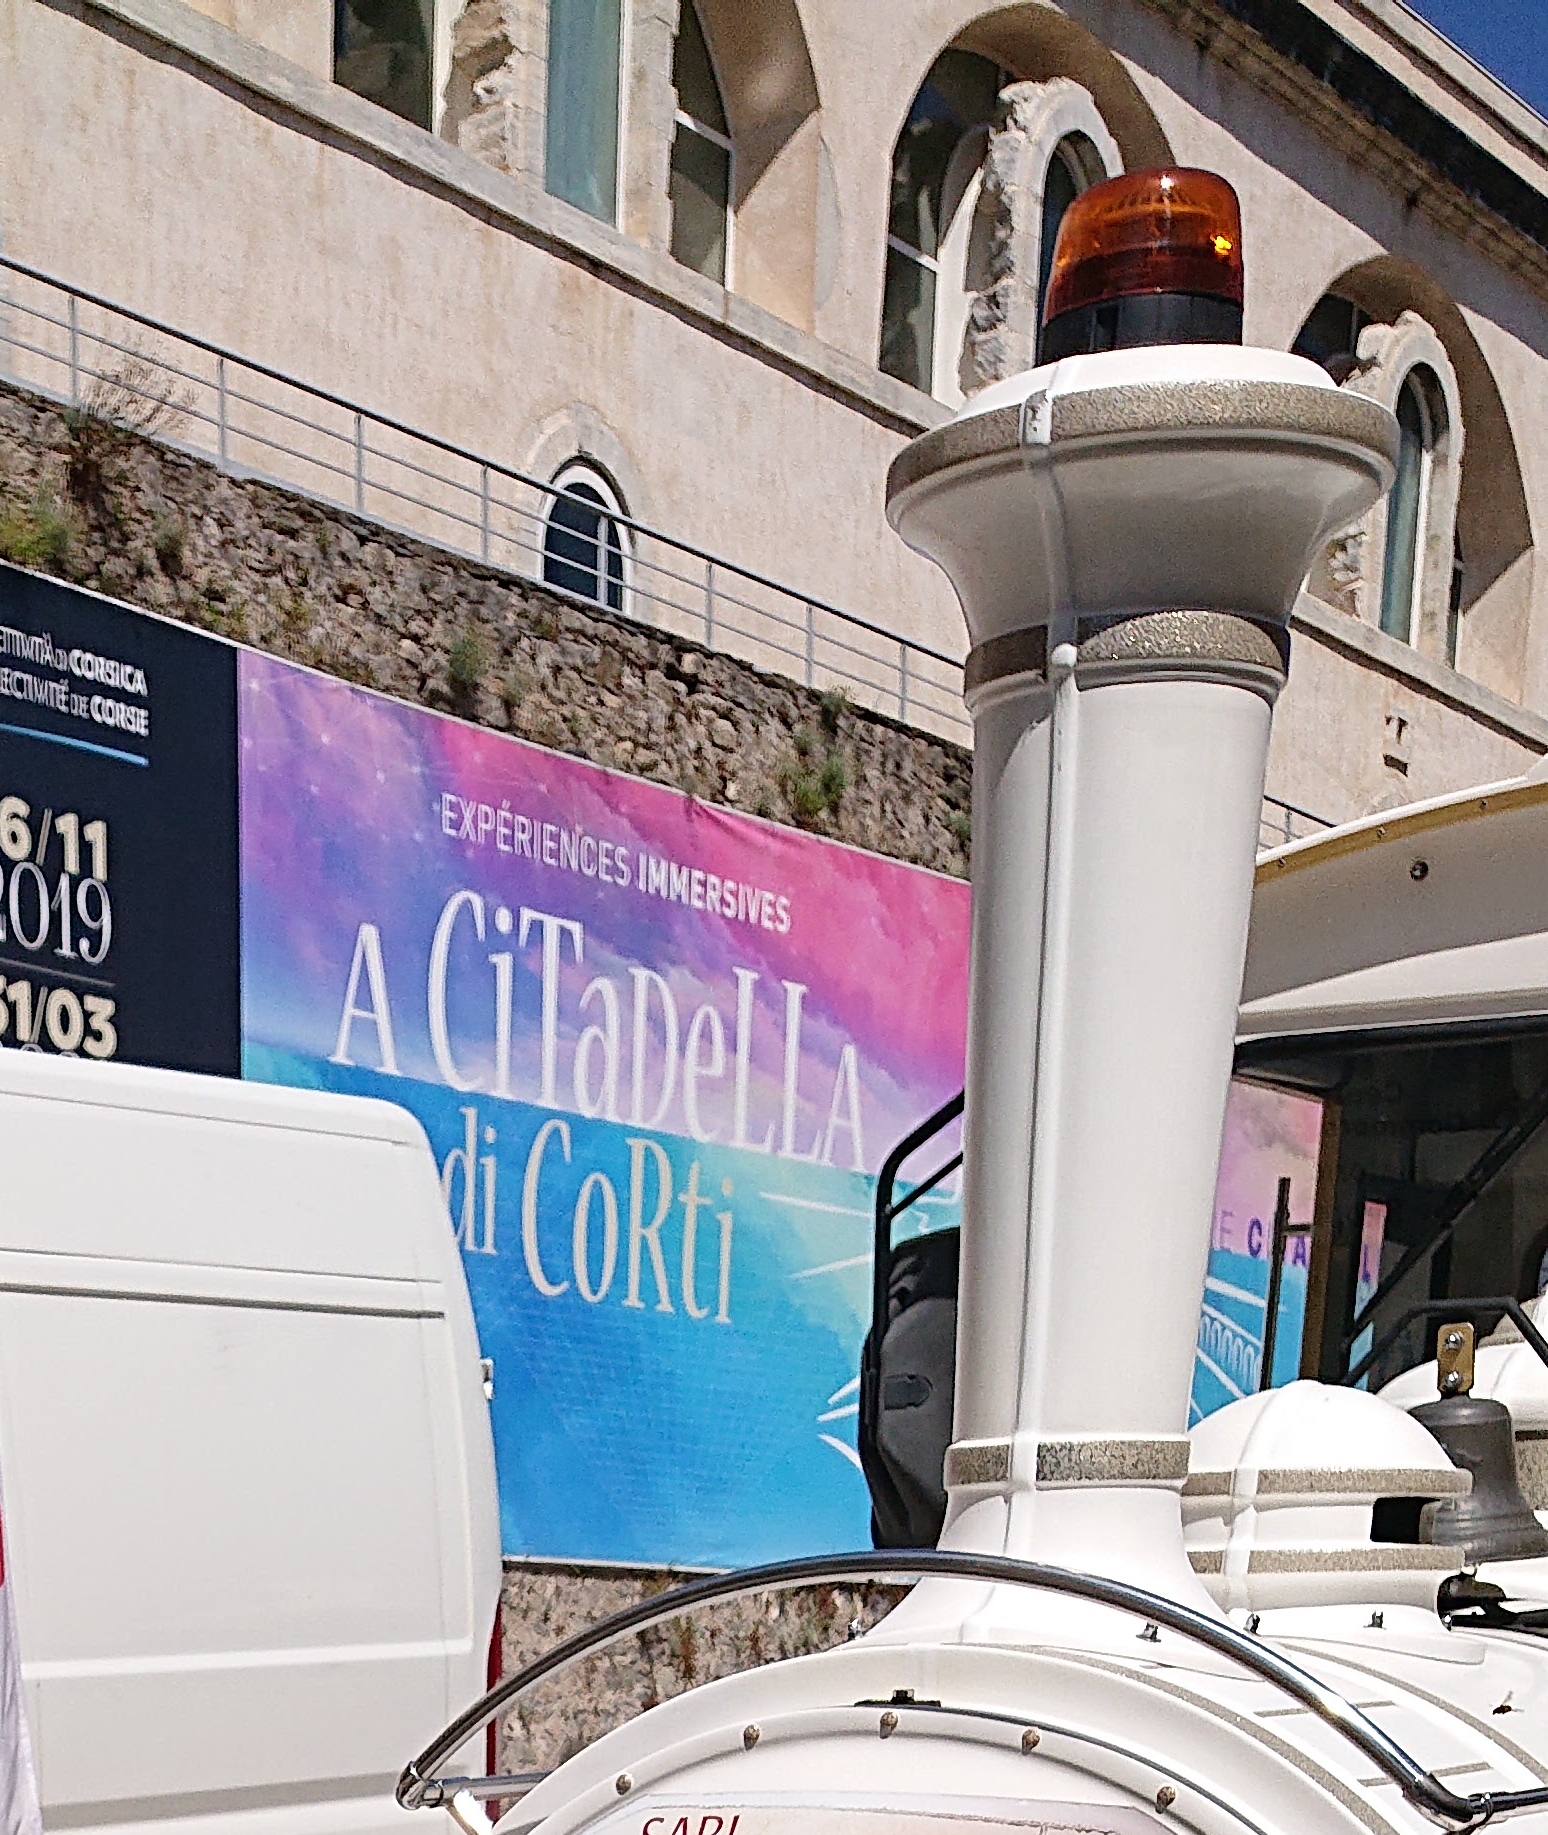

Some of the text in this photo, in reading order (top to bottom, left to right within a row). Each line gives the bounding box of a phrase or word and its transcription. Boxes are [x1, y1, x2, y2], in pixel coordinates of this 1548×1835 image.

[69, 649, 148, 698] CORSICA
[70, 692, 90, 719] DE
[90, 695, 149, 737] CORSE
[441, 792, 792, 934] EXPÉRIENCES IMMERSIVES
[329, 923, 401, 1075] A
[442, 1106, 498, 1256] di
